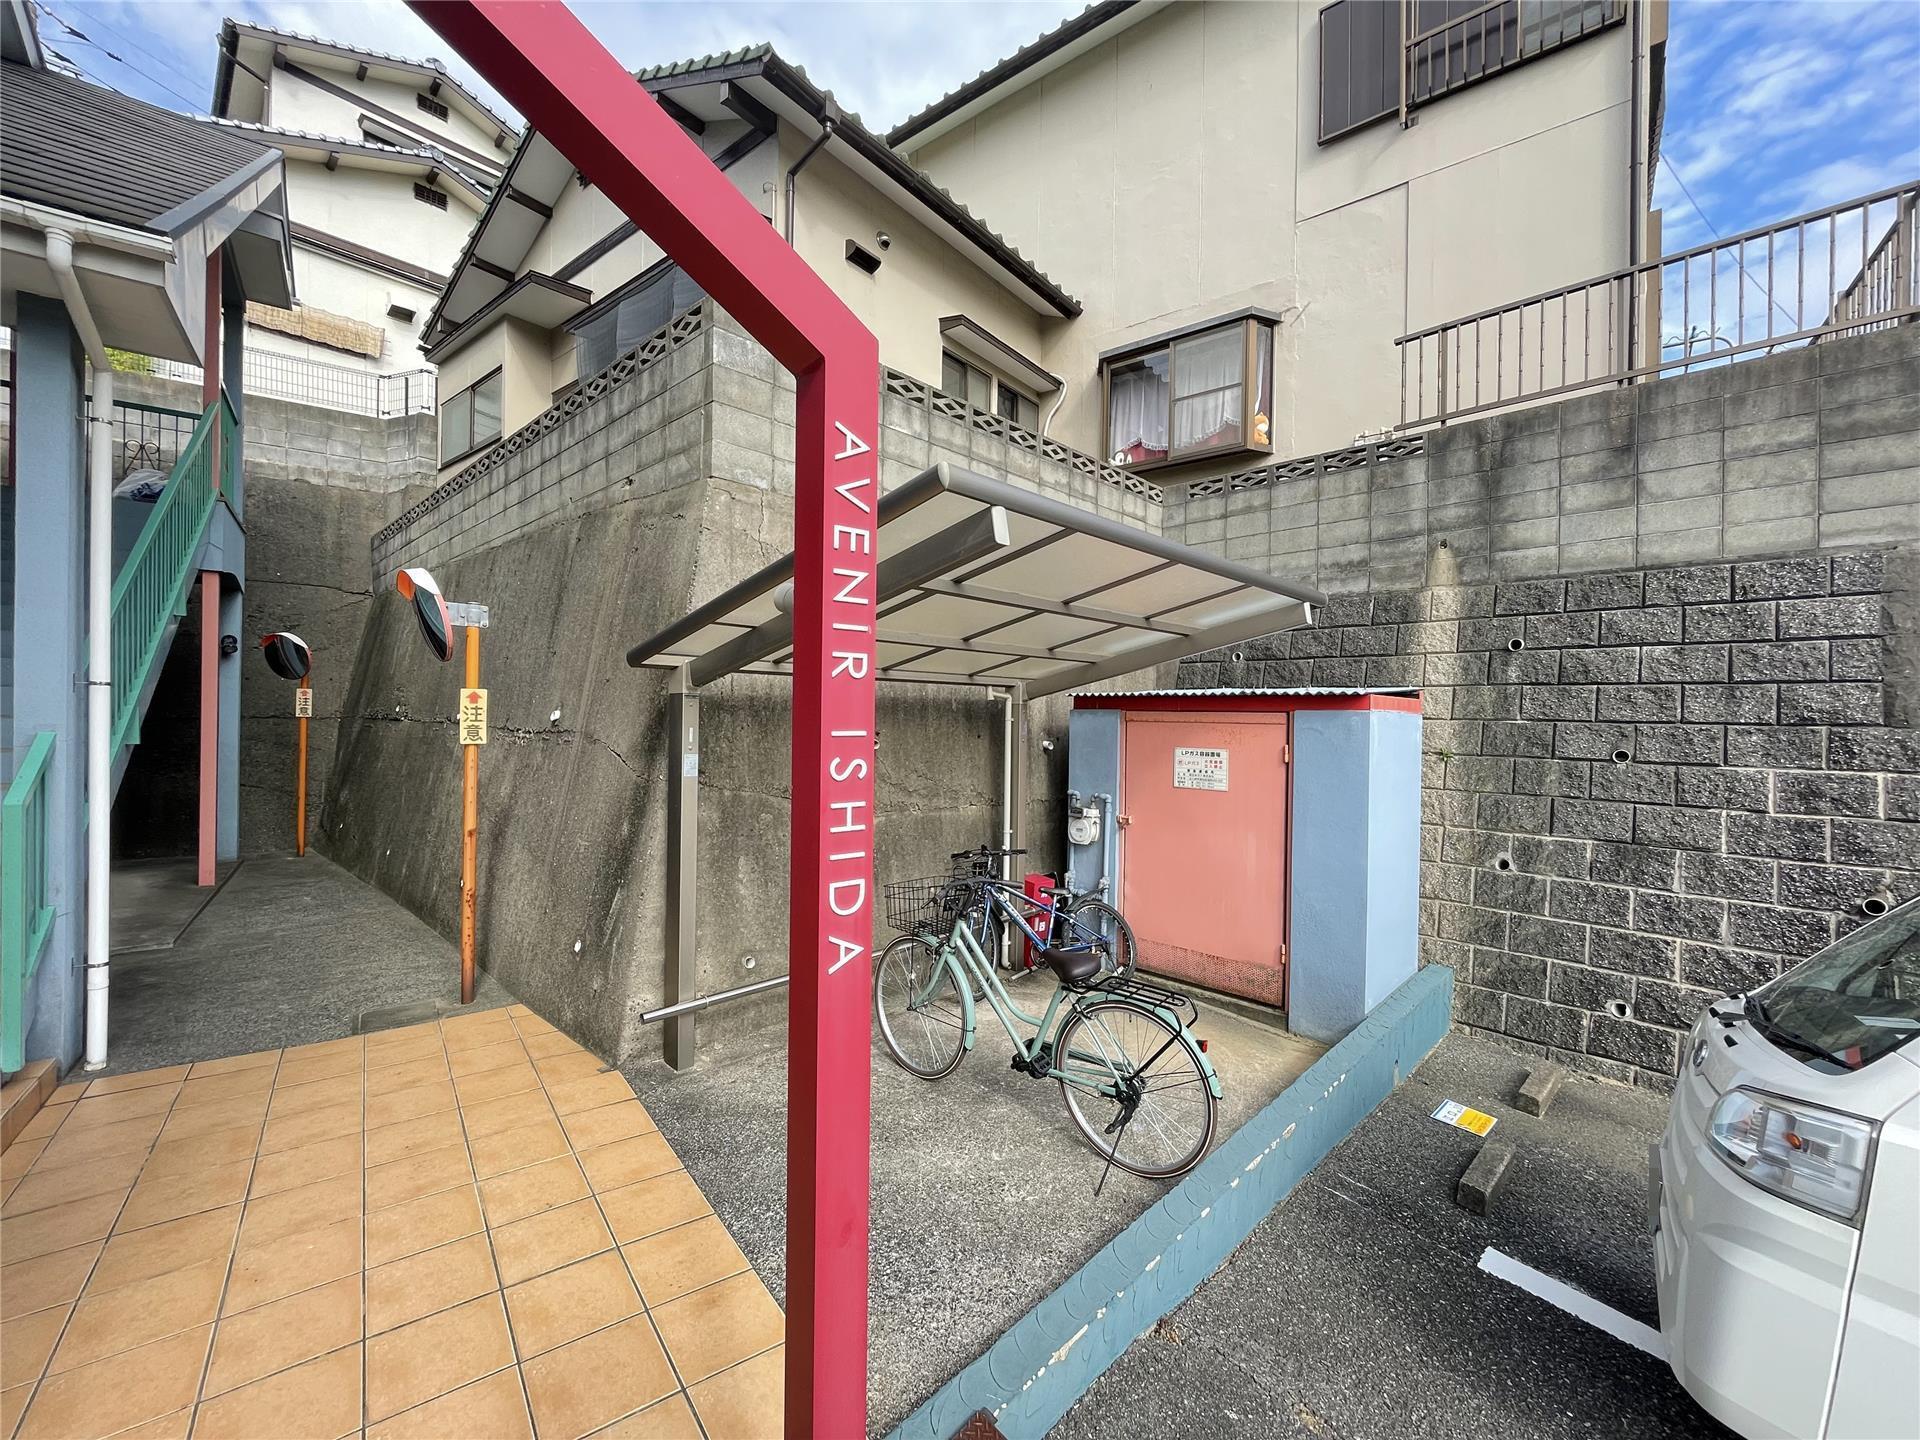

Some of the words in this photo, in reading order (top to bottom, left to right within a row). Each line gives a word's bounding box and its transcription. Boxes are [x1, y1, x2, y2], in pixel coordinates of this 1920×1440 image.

[832, 420, 871, 680] AVENIR
[297, 697, 311, 716] 注意
[462, 705, 484, 742] 注意
[828, 730, 868, 975] ISHIDA
